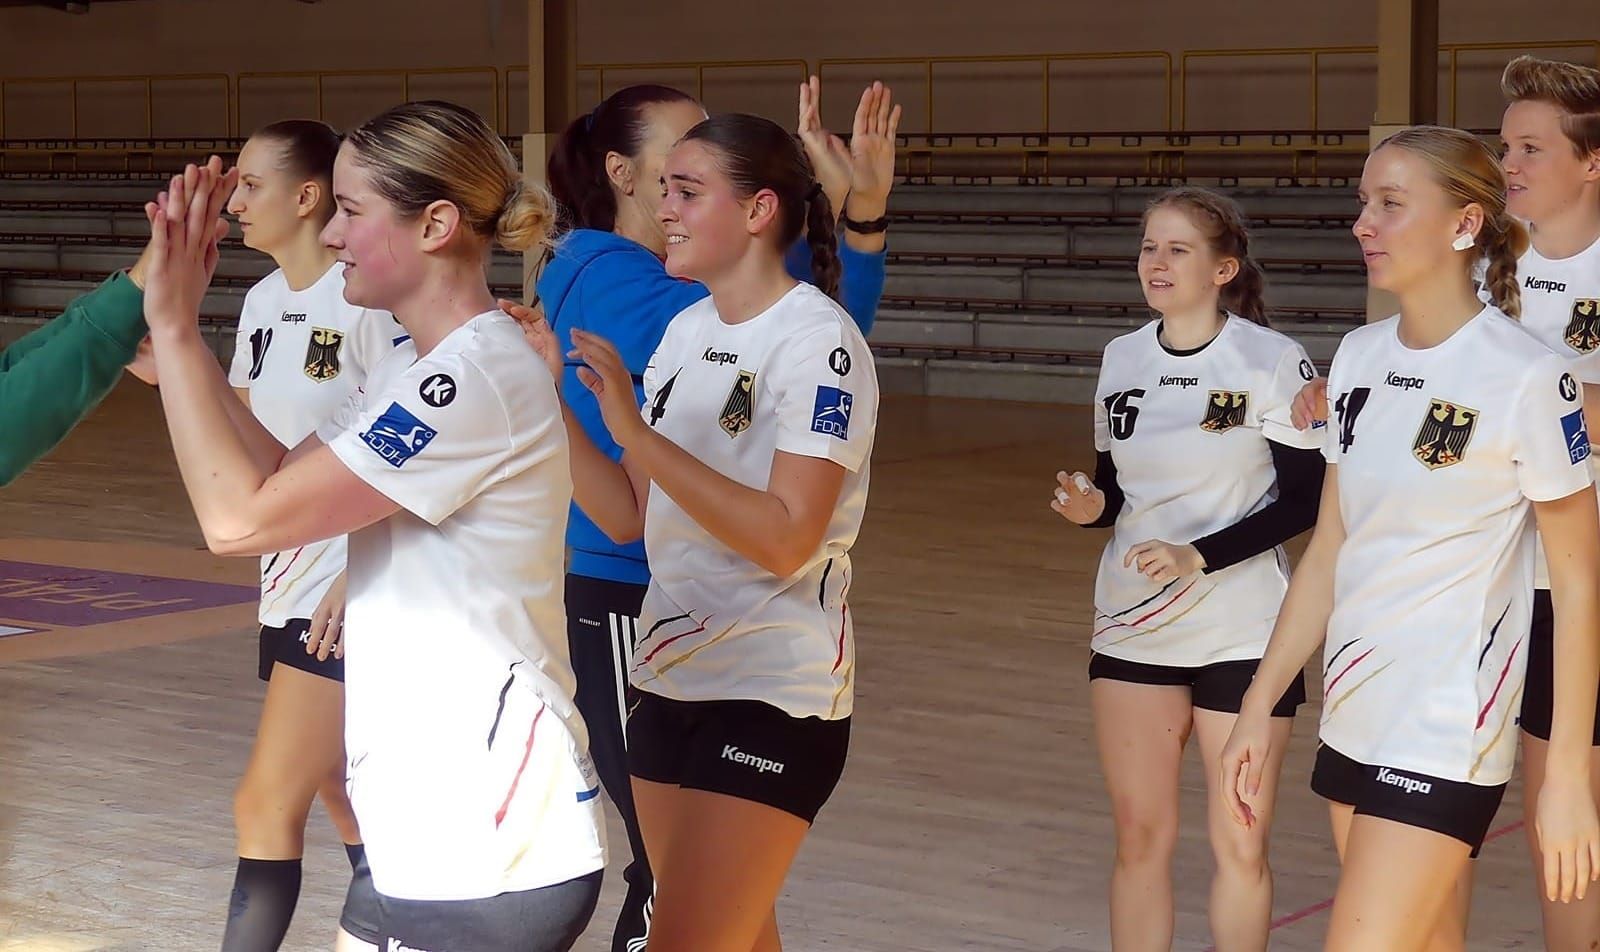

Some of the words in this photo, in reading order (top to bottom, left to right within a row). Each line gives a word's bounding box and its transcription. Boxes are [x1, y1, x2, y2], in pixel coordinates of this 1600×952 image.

[1524, 276, 1566, 293] Kempa
[701, 347, 738, 366] Kempa
[1158, 375, 1200, 390] Kempa
[1383, 370, 1425, 391] Kempa
[1102, 388, 1147, 442] 15
[1334, 387, 1372, 454] 14
[814, 418, 848, 440] FDDH
[721, 744, 785, 774] Kempa
[1376, 767, 1432, 794] Kempa
